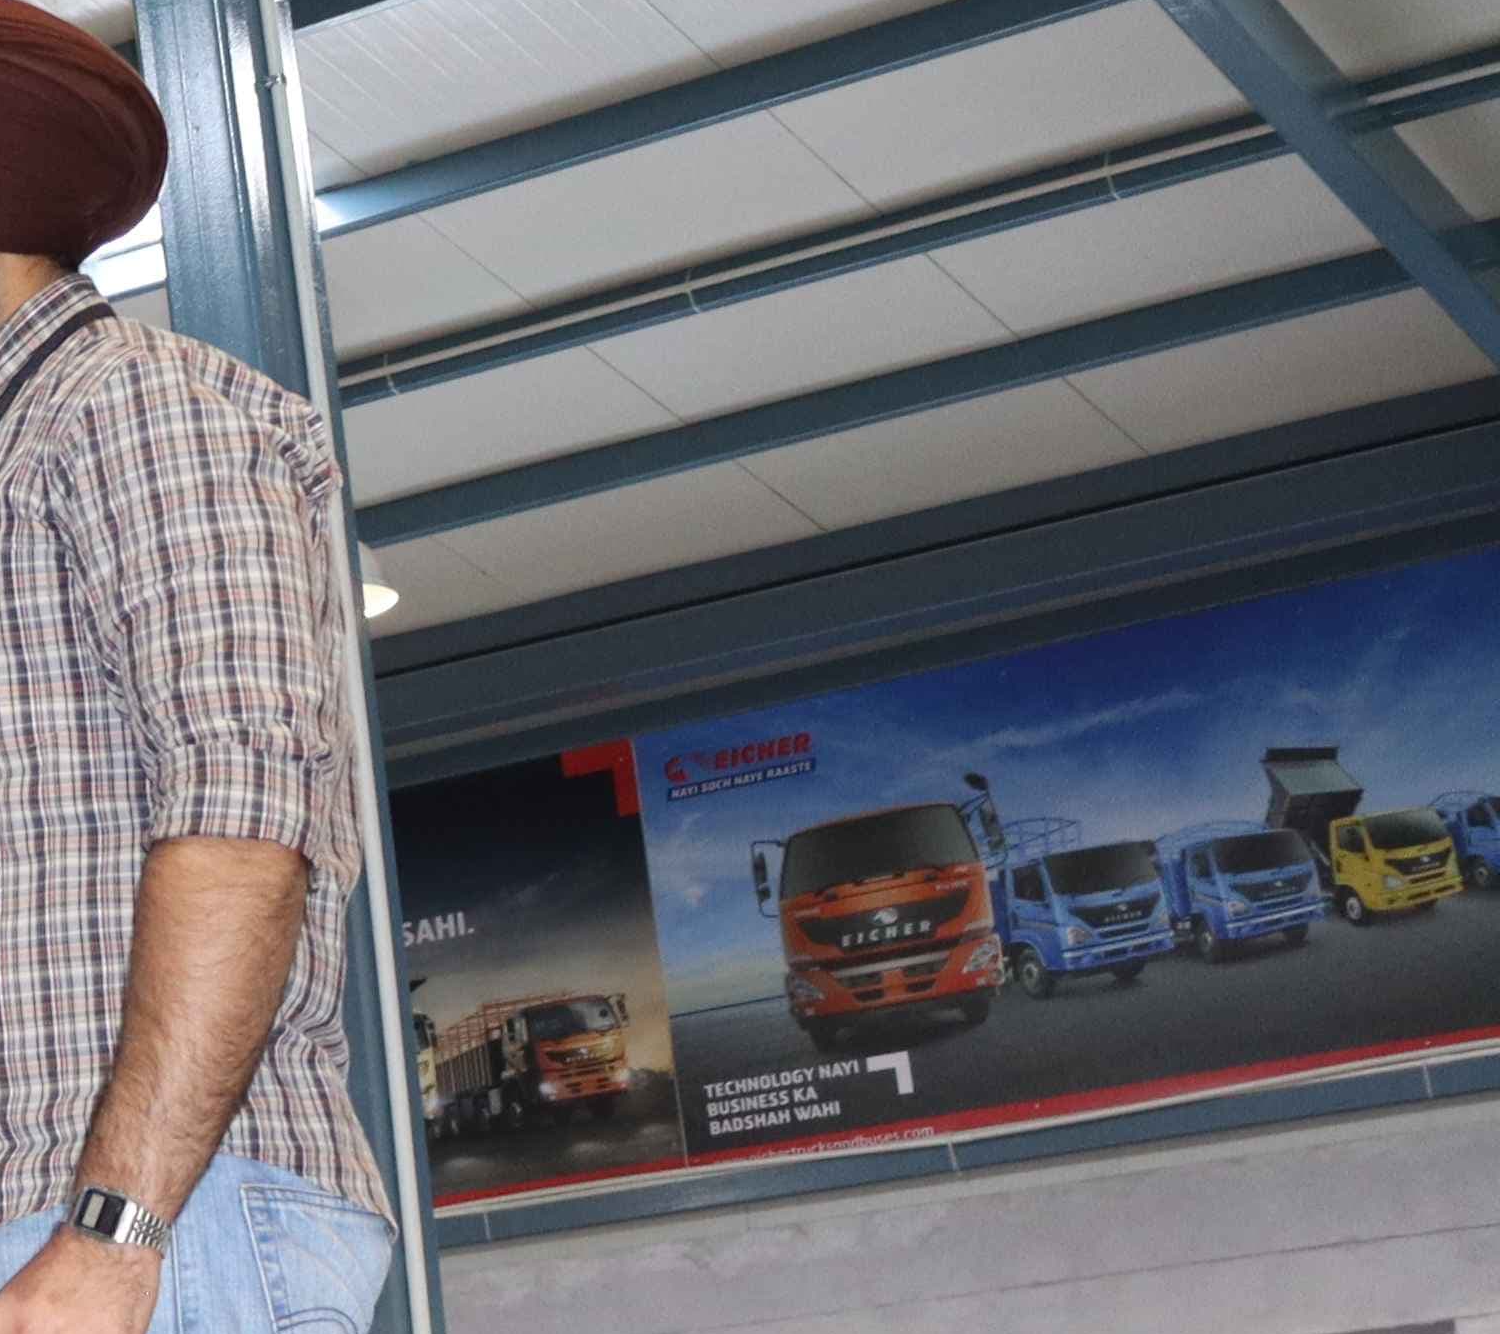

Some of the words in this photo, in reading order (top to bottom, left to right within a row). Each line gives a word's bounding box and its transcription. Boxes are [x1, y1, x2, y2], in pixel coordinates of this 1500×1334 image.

[714, 732, 812, 769] EICHER
[671, 786, 699, 799] NAYI
[700, 778, 731, 793] SOCH
[766, 760, 812, 779] RAASTE
[402, 911, 476, 948] SAHI.
[841, 919, 932, 948] EICHER
[703, 1067, 814, 1100] TECHNOLOGY
[818, 1058, 860, 1081] NAYI
[706, 1091, 790, 1118] BUSINESS
[793, 1086, 819, 1104] KA
[709, 1108, 791, 1136] BADSHAH
[794, 1100, 842, 1122] WAHI
